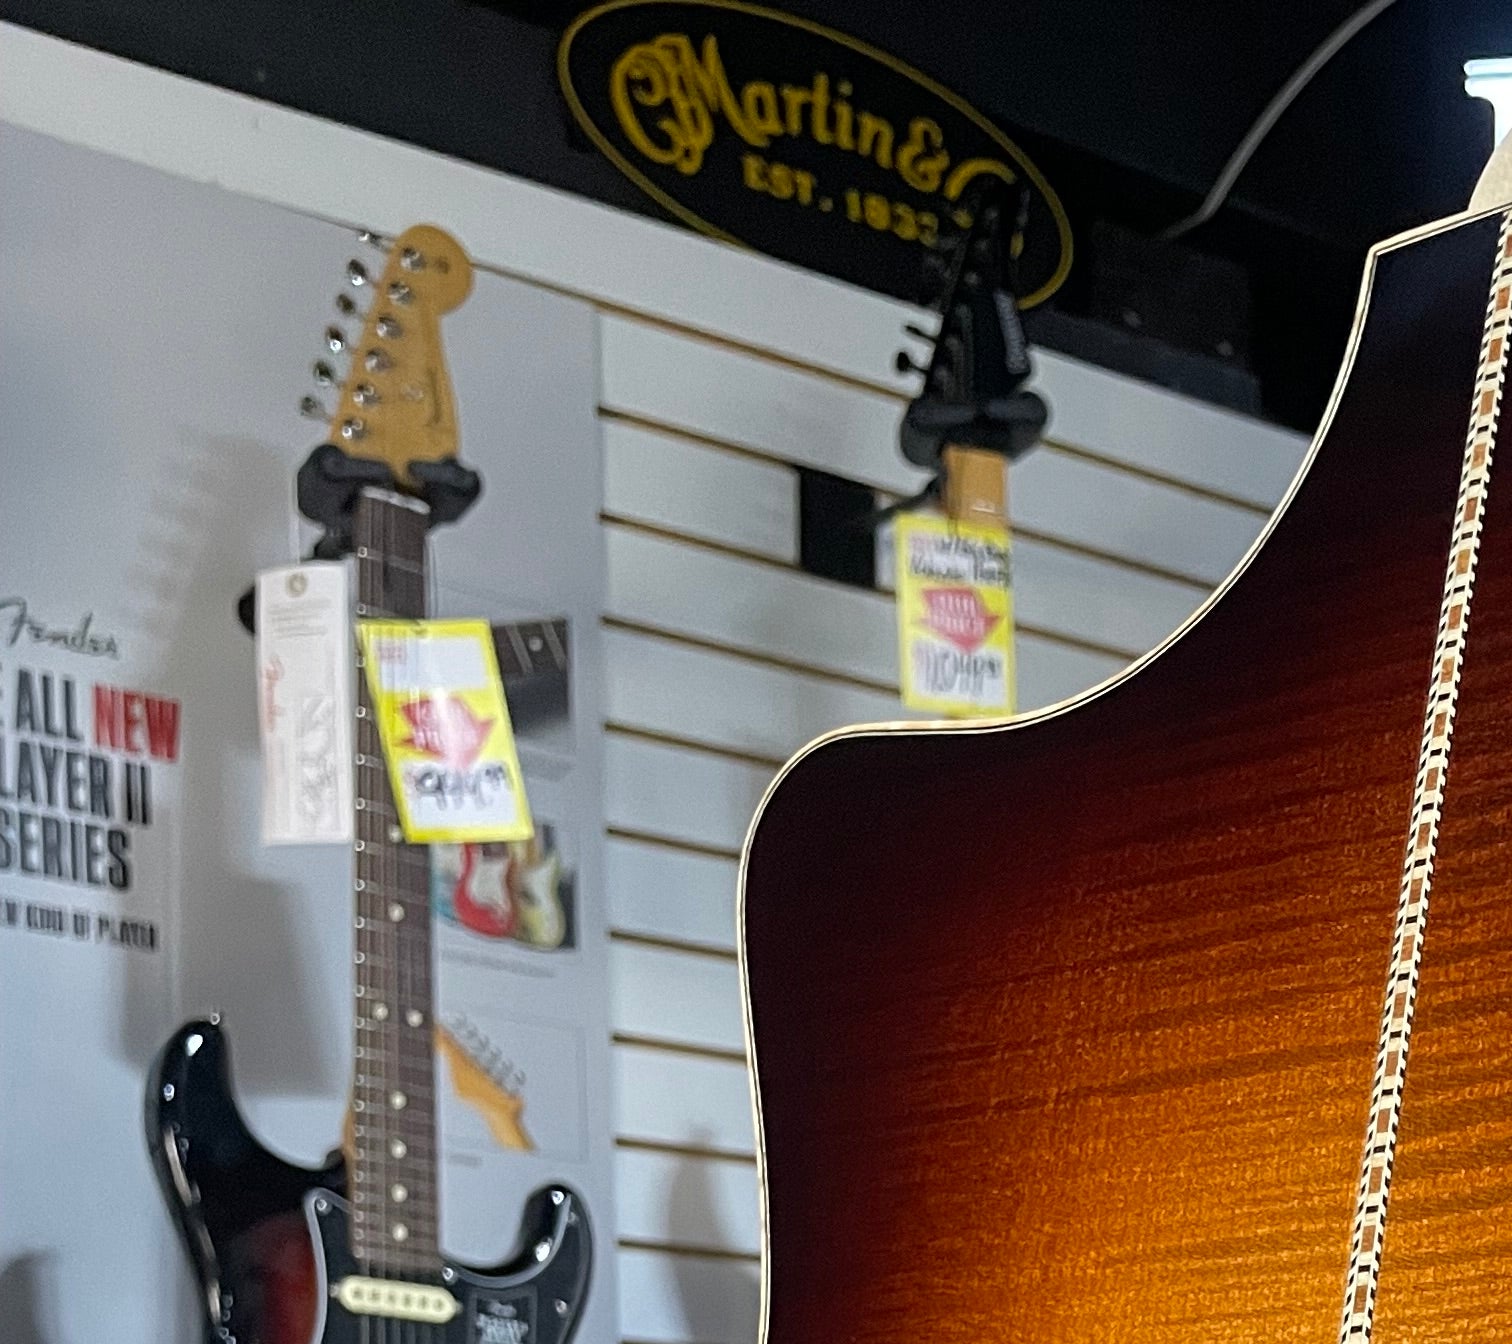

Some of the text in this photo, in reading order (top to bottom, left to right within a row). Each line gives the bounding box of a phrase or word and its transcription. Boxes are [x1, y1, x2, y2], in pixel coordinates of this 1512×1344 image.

[16, 668, 83, 741] ALL
[91, 680, 182, 761] NEW
[0, 806, 130, 889] SERIES
